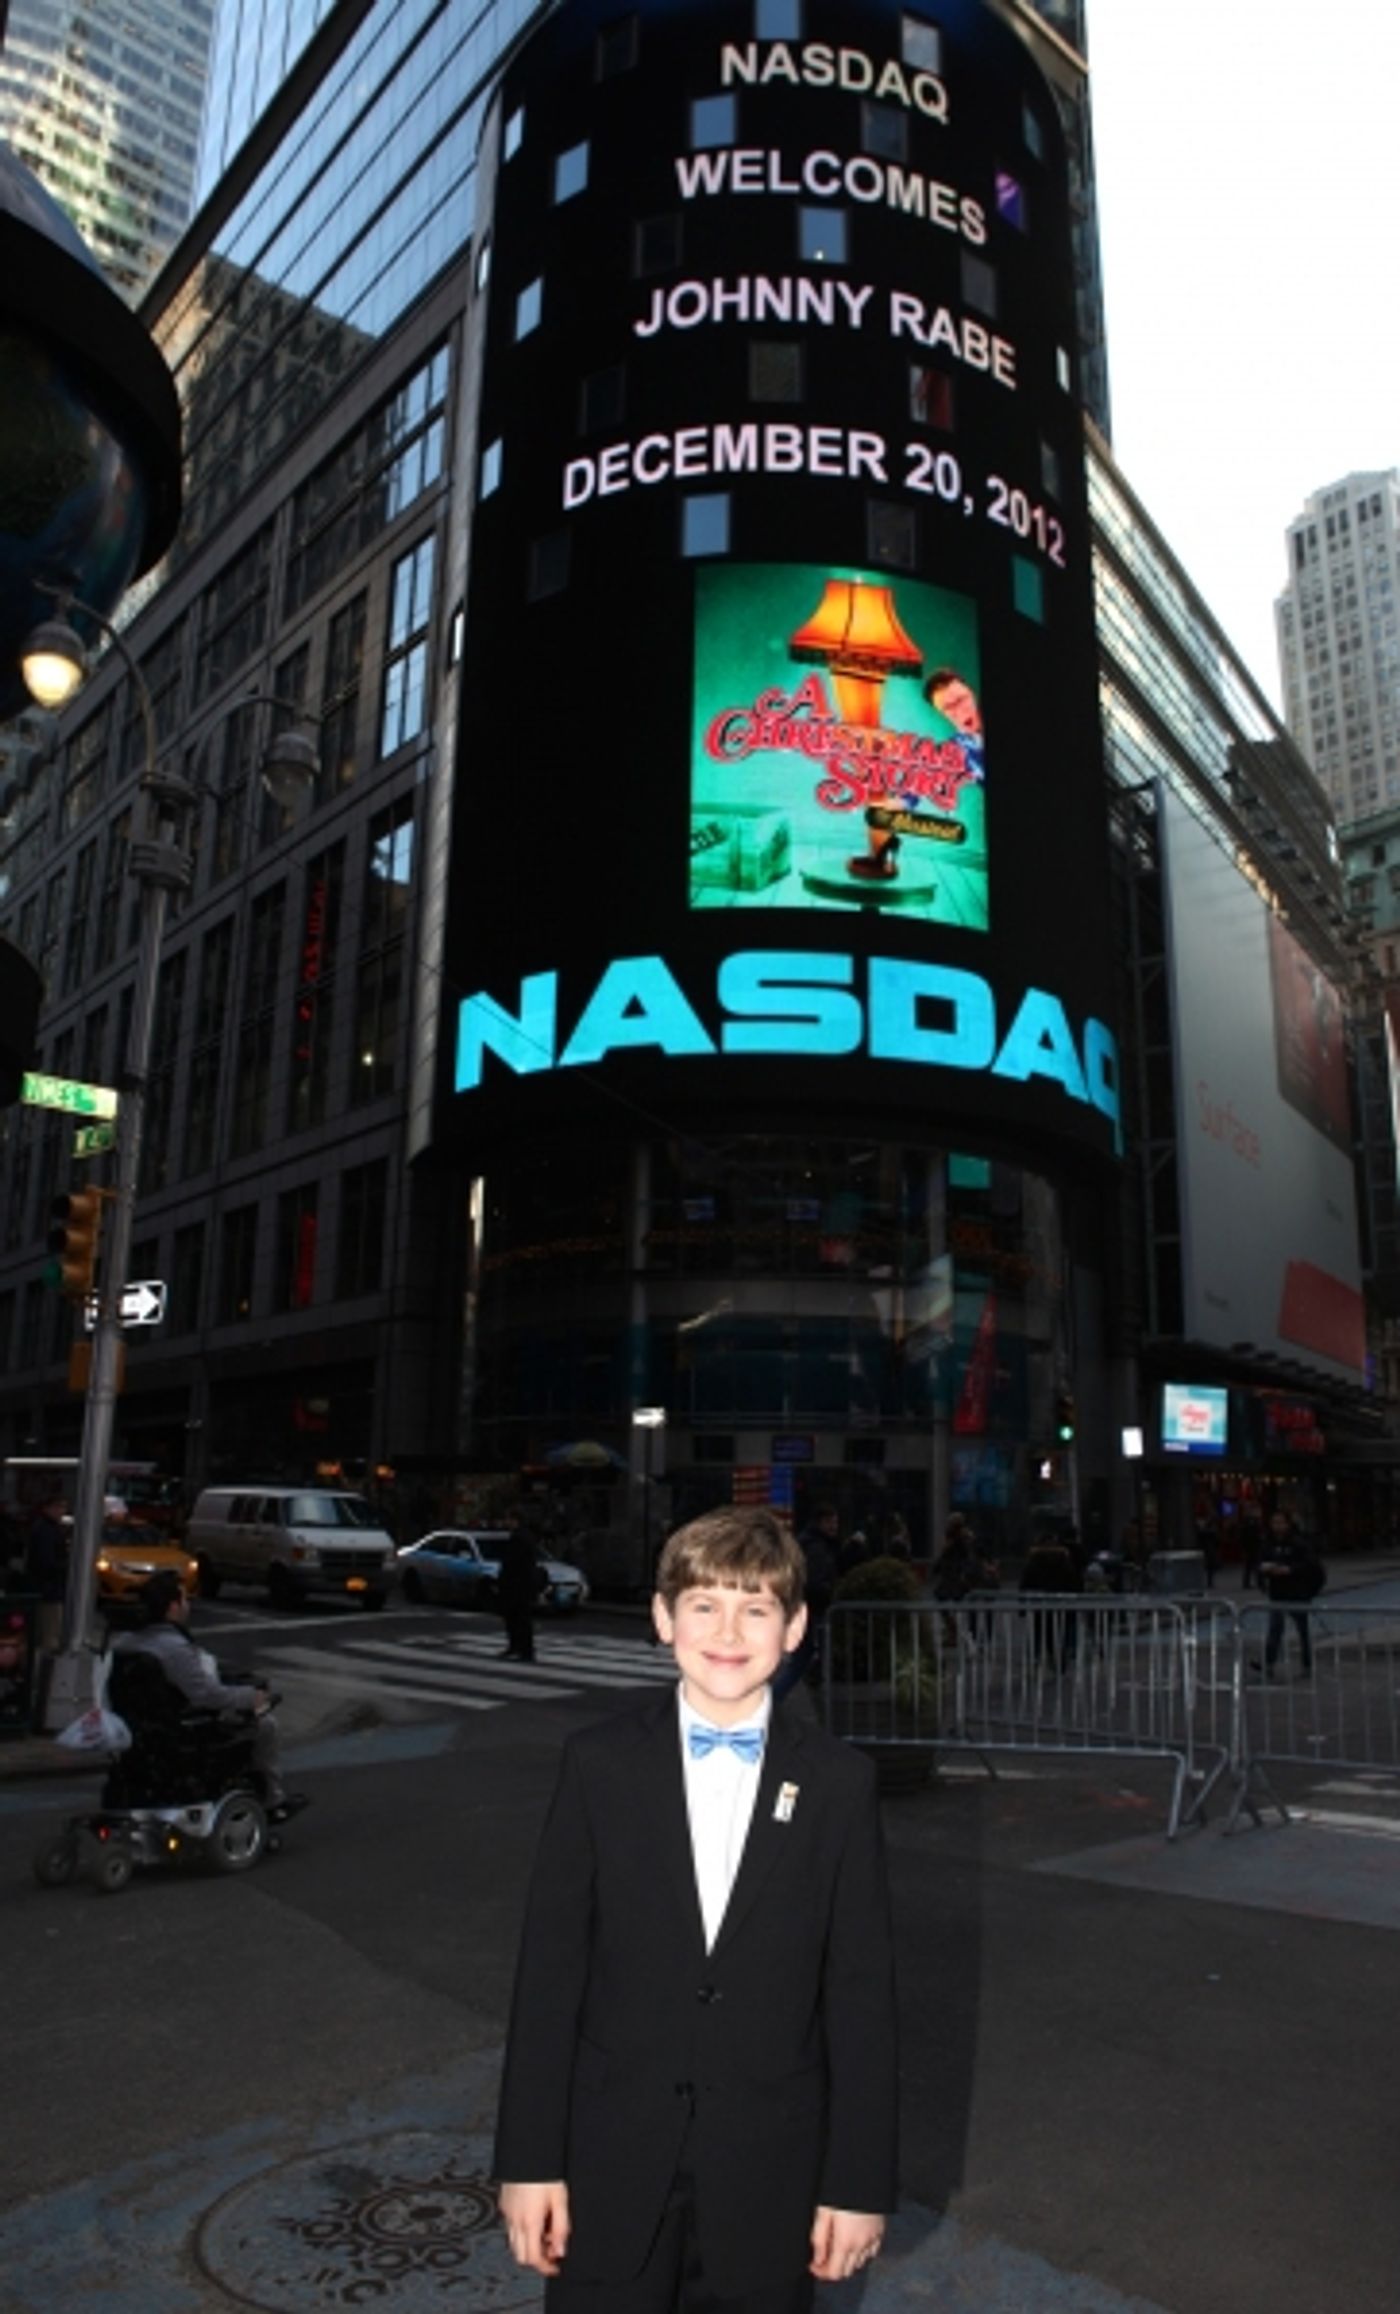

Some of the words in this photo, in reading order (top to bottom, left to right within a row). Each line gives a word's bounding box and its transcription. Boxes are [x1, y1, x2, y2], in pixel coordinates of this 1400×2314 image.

[721, 43, 948, 124] NASDAQ
[675, 150, 986, 245] WELCOMES
[634, 276, 873, 337] JOHNNY
[890, 292, 1016, 389] RABE
[563, 424, 888, 510] DECEMBER
[905, 443, 974, 515] 20,
[986, 476, 1066, 567] 2012
[754, 672, 836, 722] A
